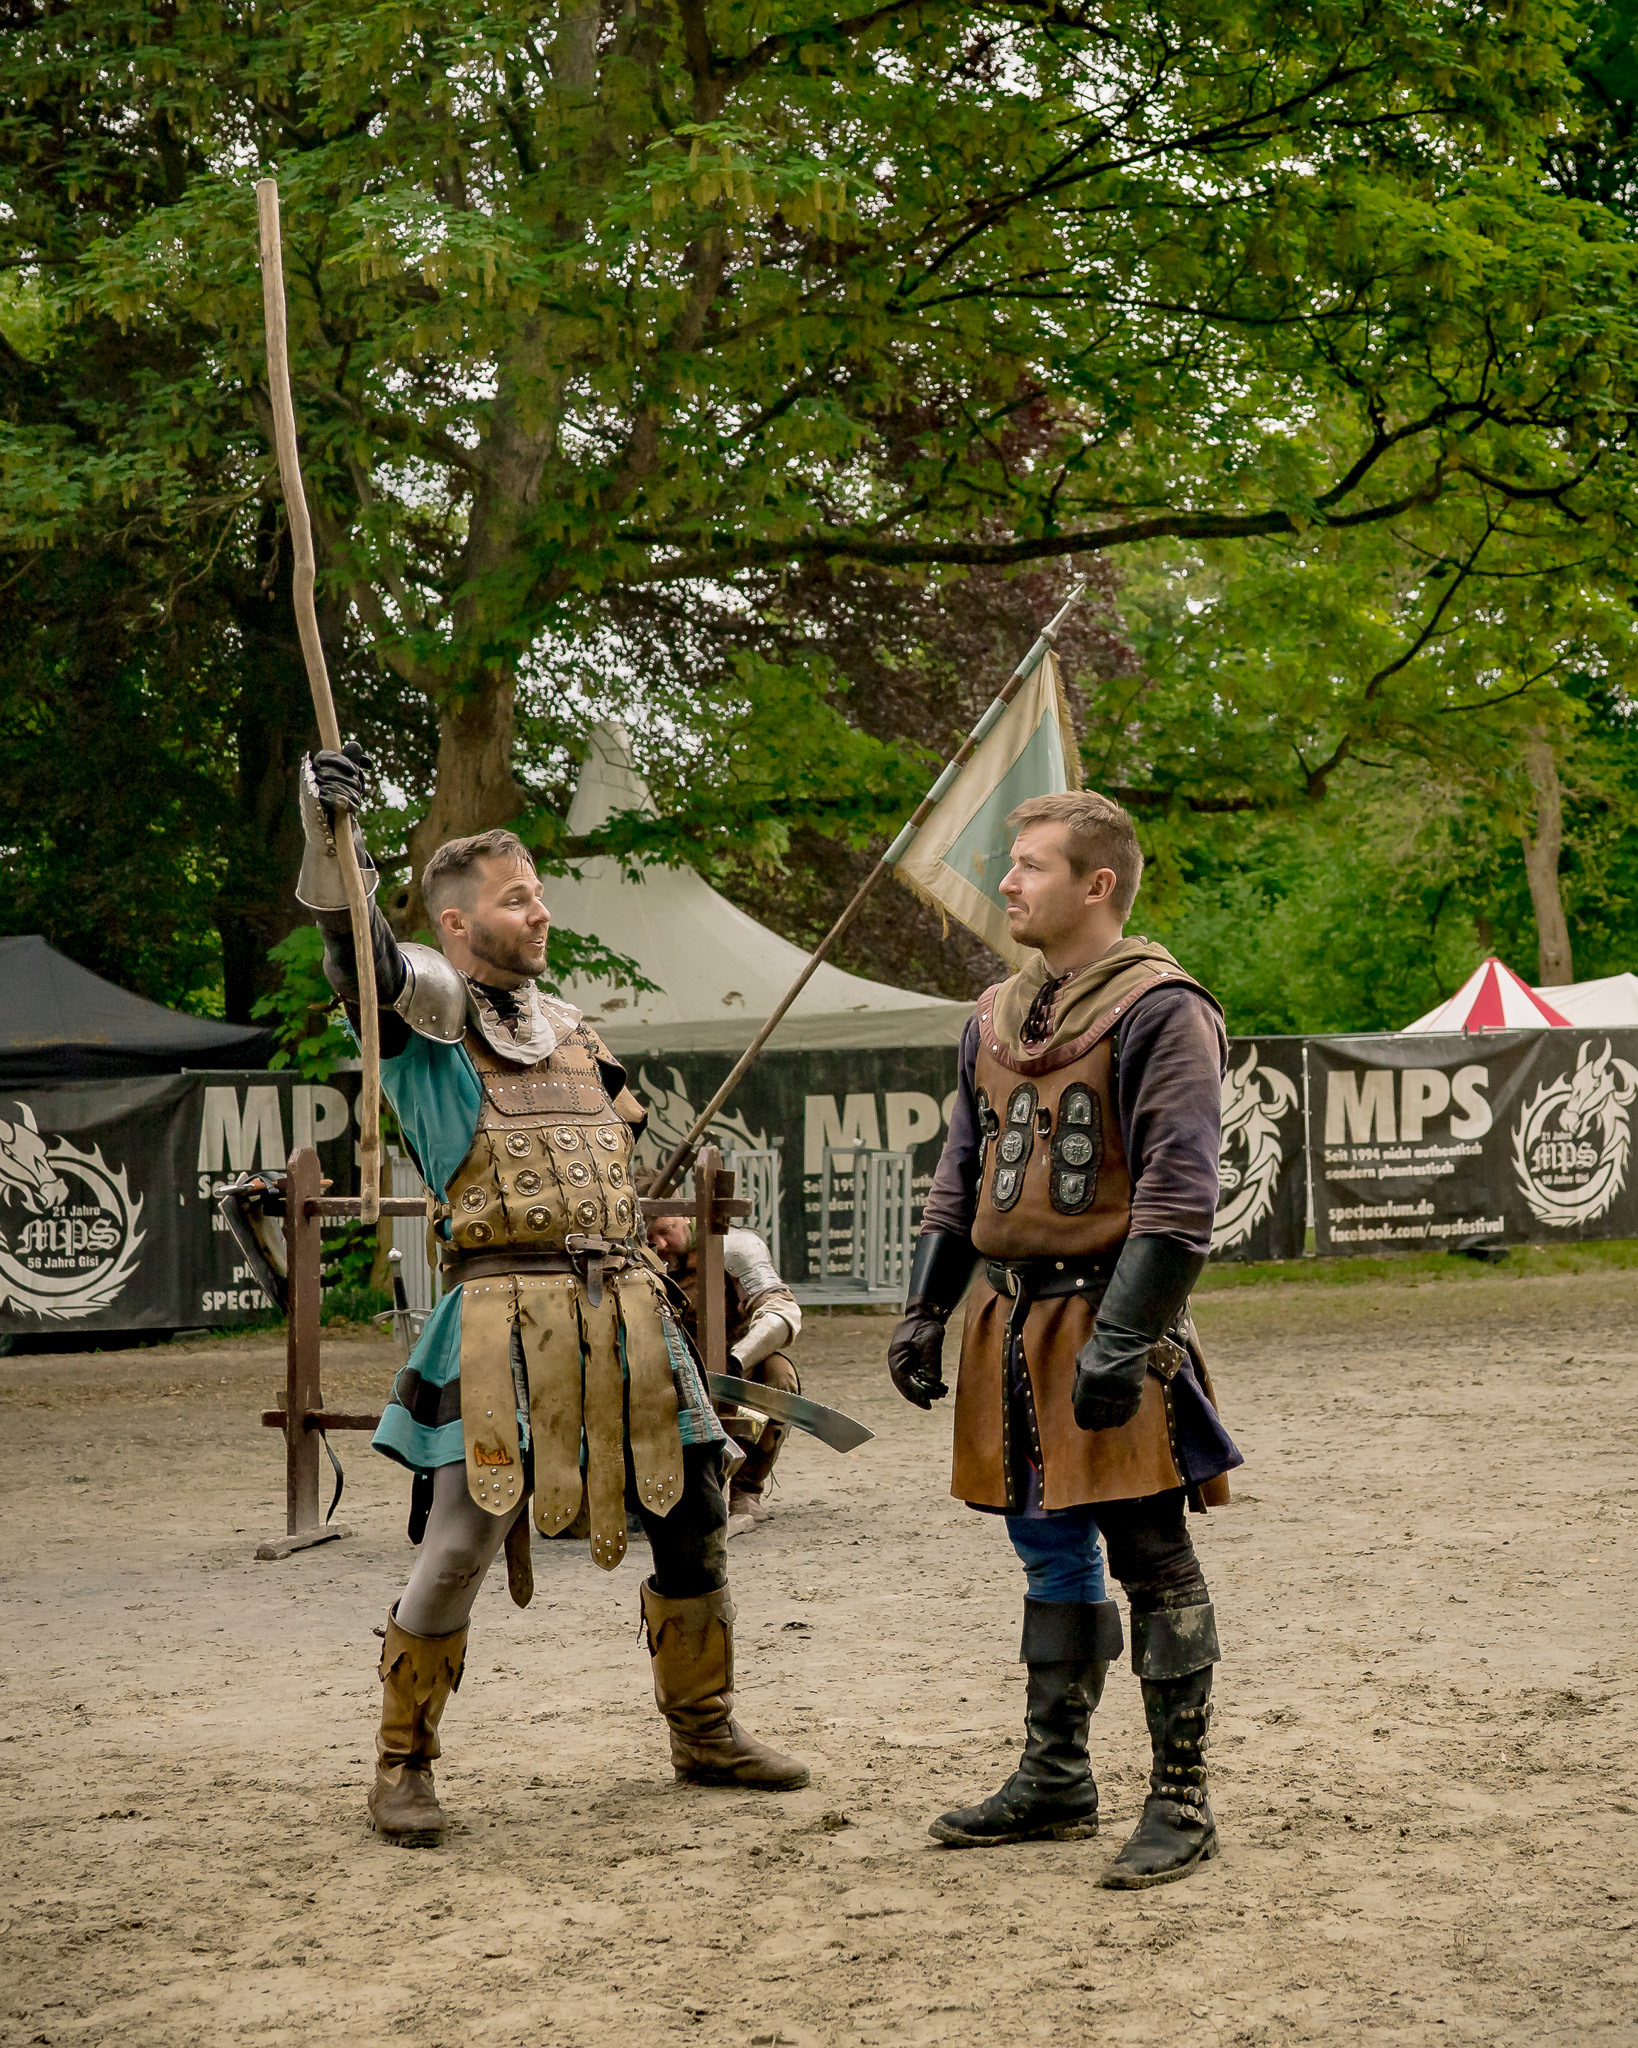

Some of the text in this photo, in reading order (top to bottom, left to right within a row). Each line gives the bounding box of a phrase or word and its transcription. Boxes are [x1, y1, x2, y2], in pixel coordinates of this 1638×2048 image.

[1324, 1065, 1493, 1145] MPS
[197, 1084, 385, 1172] MP
[804, 1088, 959, 1174] MP
[1324, 1141, 1483, 1162] Seit 1994 nicht authentisch
[1529, 1141, 1599, 1173] MPS
[1325, 1160, 1455, 1180] sondern phantastisch
[52, 1205, 101, 1217] 21 Jahre
[1328, 1198, 1435, 1223] spectaculum.de
[15, 1219, 121, 1256] MPS
[1329, 1215, 1505, 1243] facebook.com/mpsfestival
[27, 1255, 99, 1269] 56 Jahre Gisi
